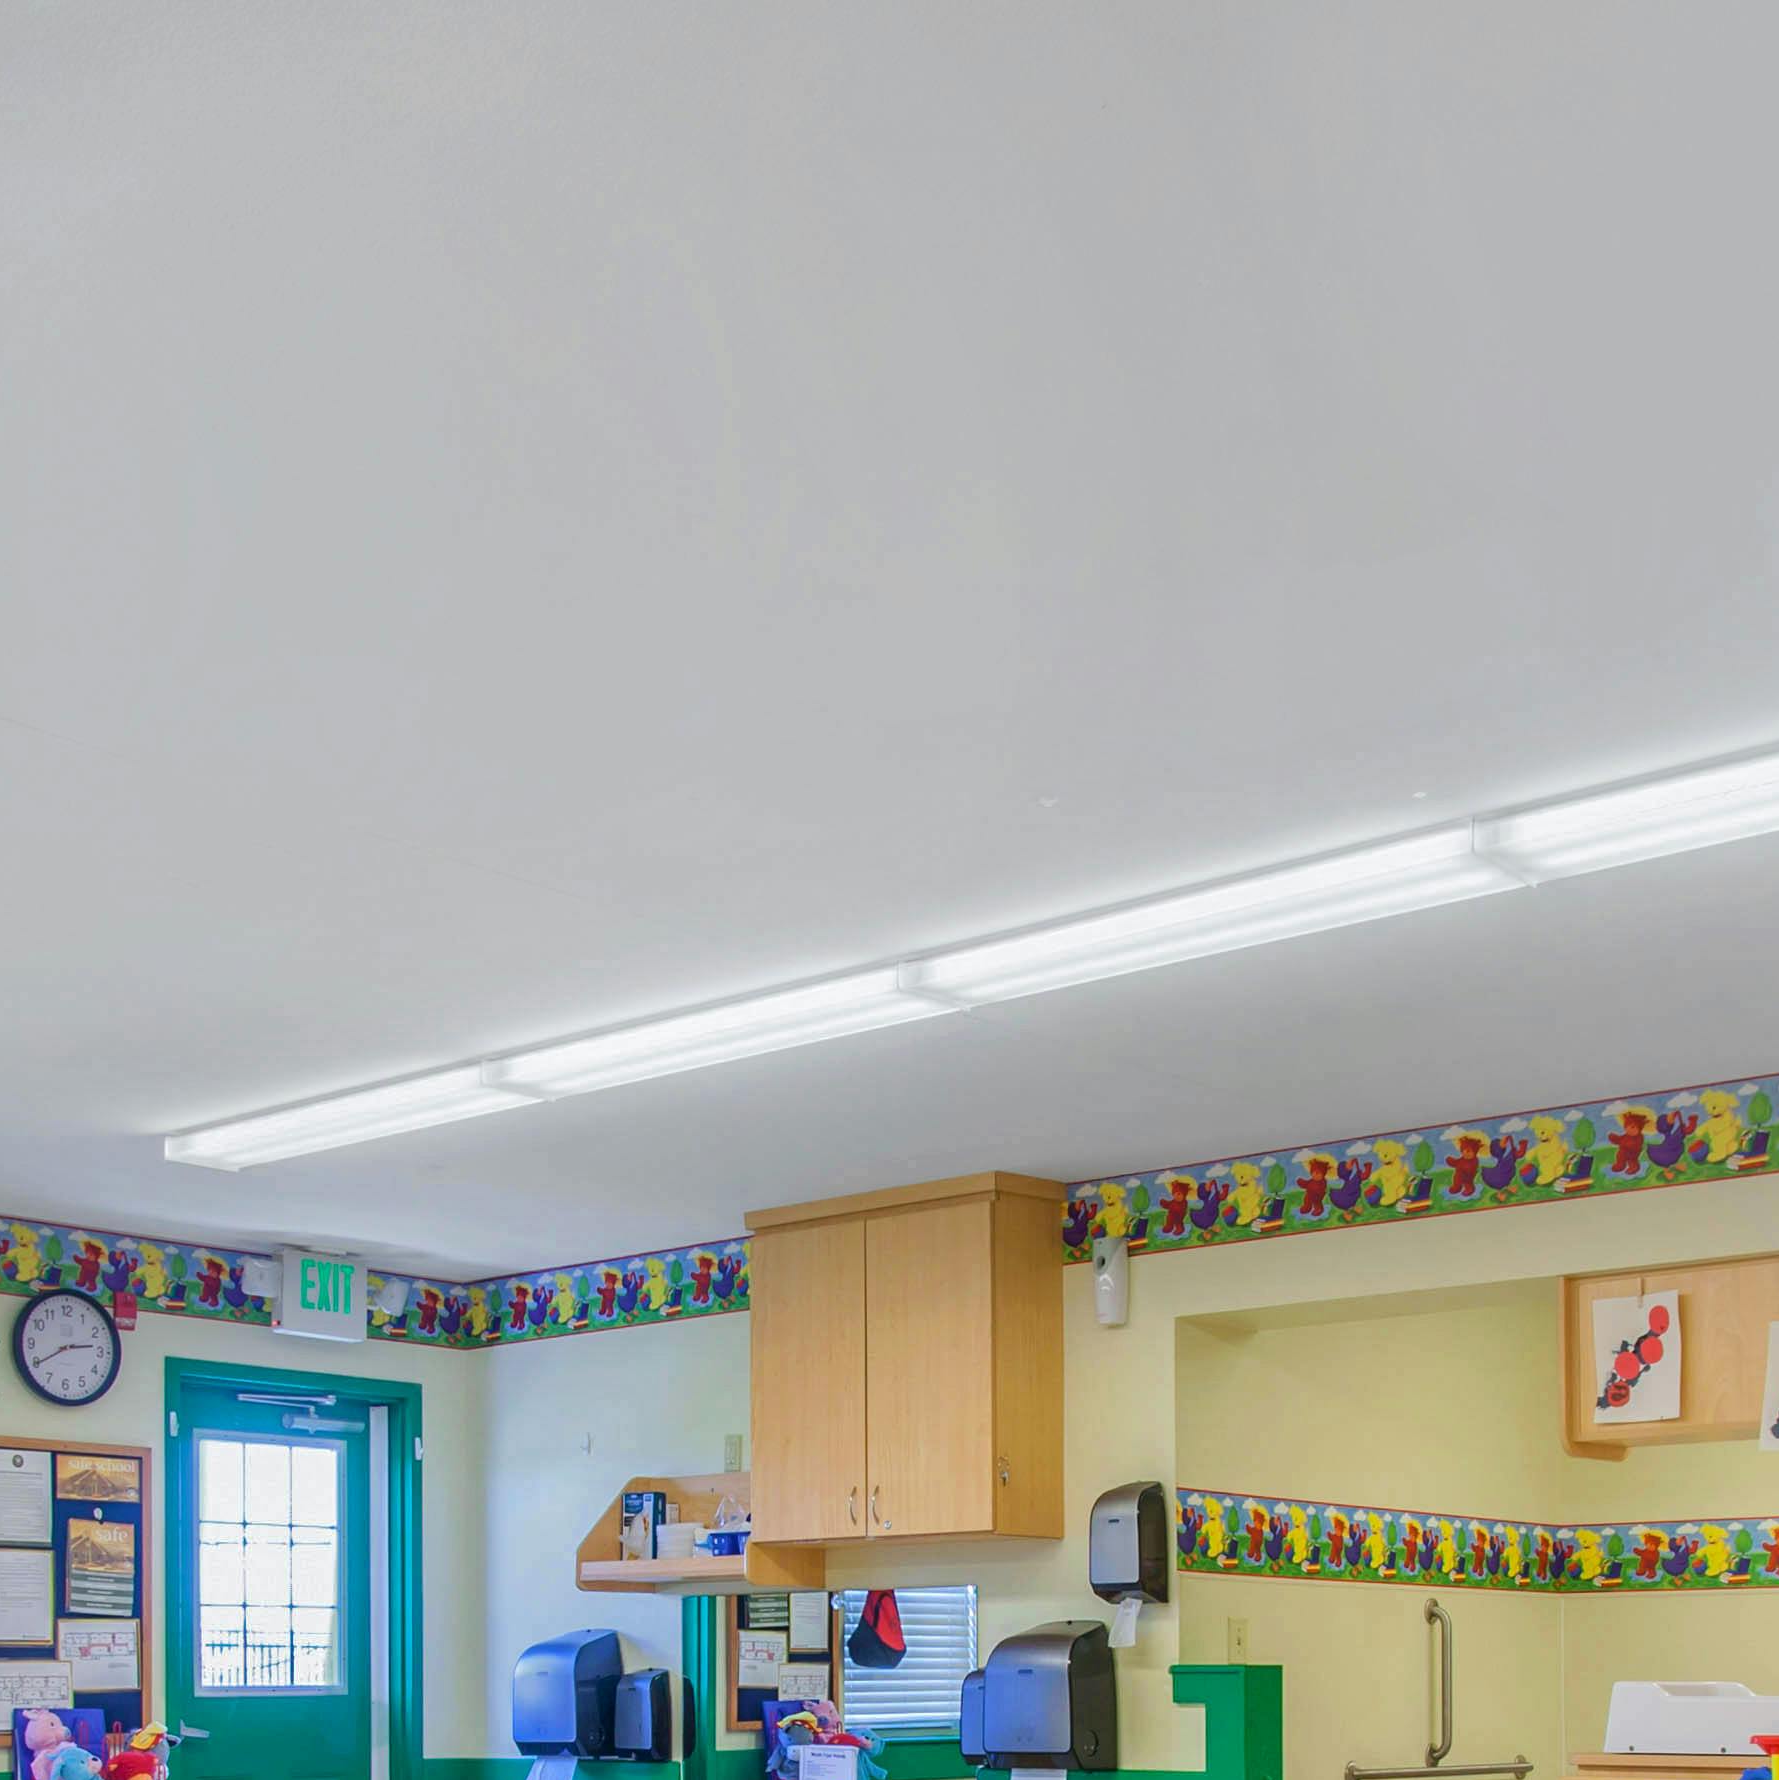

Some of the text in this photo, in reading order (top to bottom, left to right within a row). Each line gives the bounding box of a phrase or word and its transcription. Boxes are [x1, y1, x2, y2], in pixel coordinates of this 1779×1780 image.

[301, 1258, 355, 1315] EXIT
[45, 1309, 55, 1320] 11
[62, 1305, 72, 1317] 12
[34, 1319, 45, 1331] 10
[80, 1314, 85, 1324] 1
[92, 1327, 99, 1338] 2
[28, 1338, 35, 1349] 9
[96, 1346, 104, 1358] 3
[33, 1356, 40, 1368] 8
[91, 1364, 98, 1375] 4
[45, 1372, 53, 1383] 7
[78, 1376, 86, 1387] 5
[62, 1378, 69, 1390] 6
[96, 1459, 136, 1473] school
[95, 1528, 129, 1543] safe
